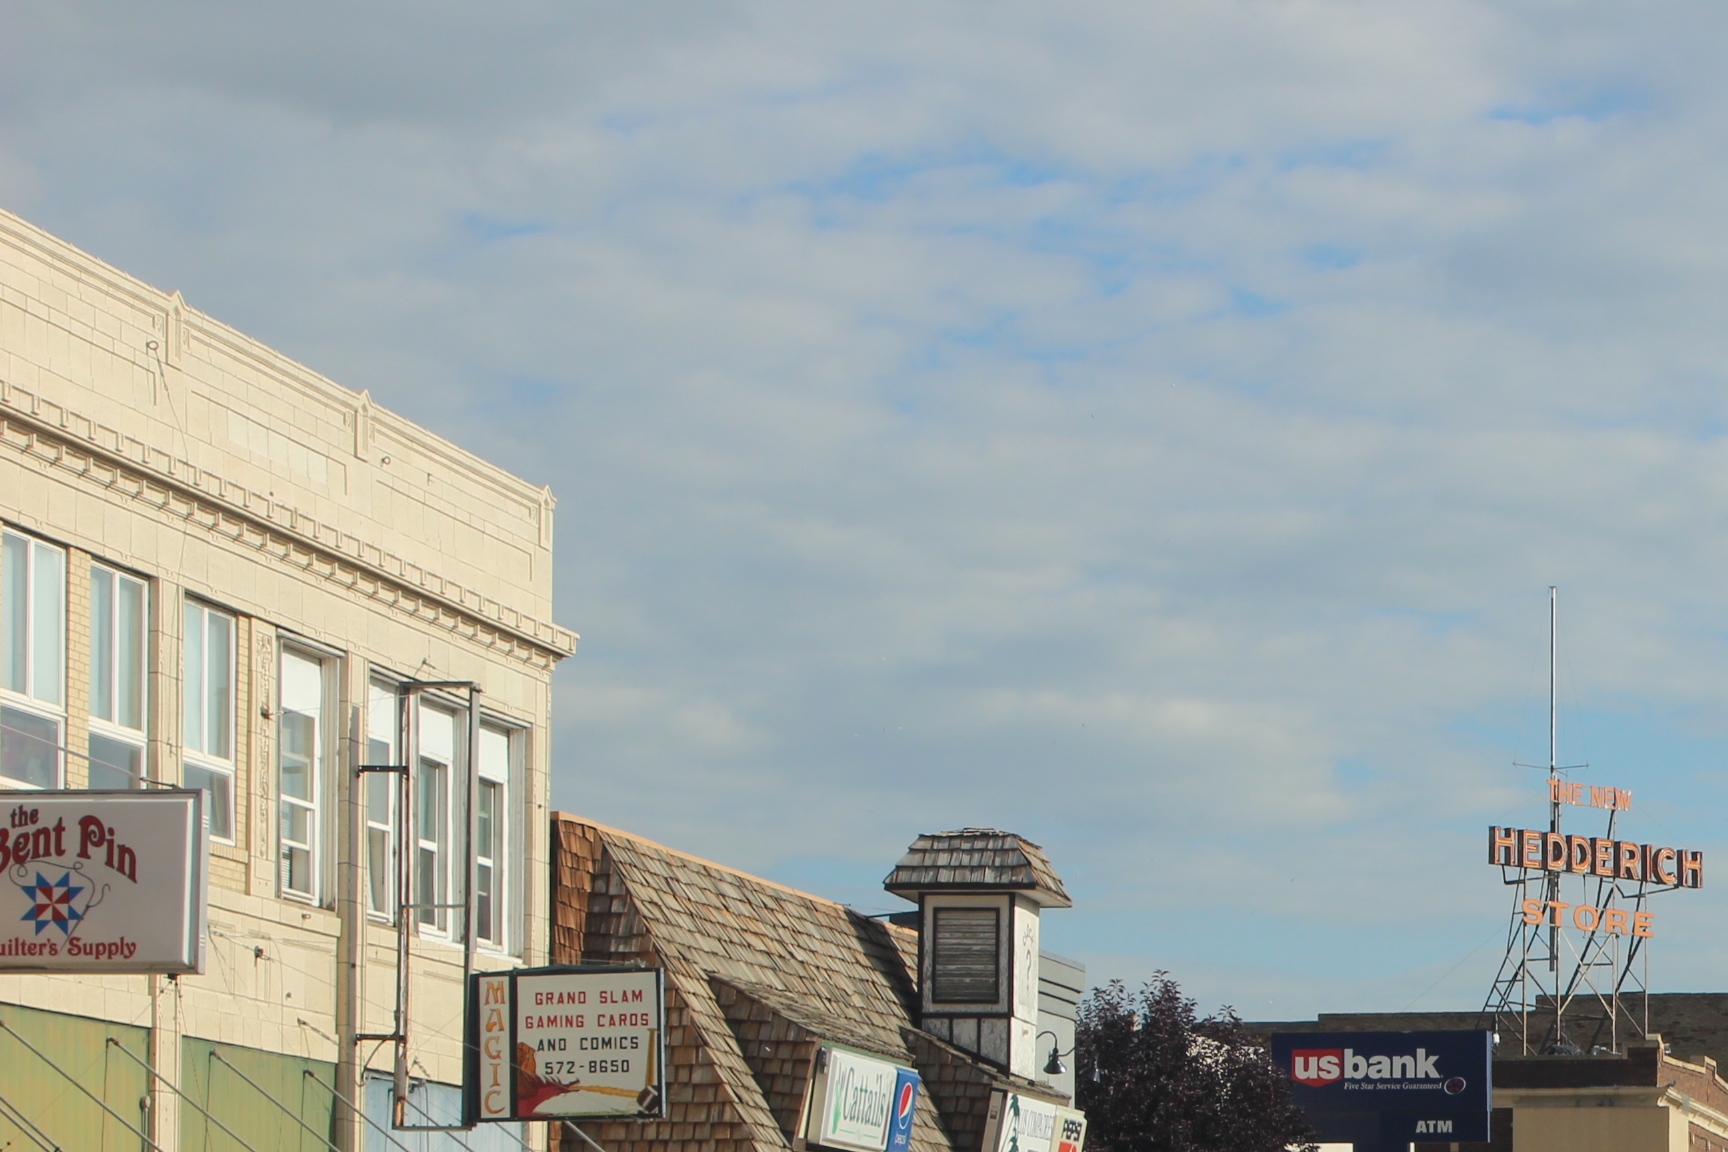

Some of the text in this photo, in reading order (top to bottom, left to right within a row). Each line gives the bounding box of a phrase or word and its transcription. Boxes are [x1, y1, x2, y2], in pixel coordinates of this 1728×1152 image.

[1547, 779, 1632, 811] THE NEW
[10, 804, 39, 829] the
[76, 815, 137, 884] Pin
[1488, 825, 1703, 889] HEDDERICH
[1522, 898, 1655, 938] STORE
[67, 936, 137, 960] Supply
[535, 990, 643, 1006] GRAND SLAM
[525, 1012, 650, 1030] GAMING CARDS
[483, 981, 507, 1115] MAGIC
[537, 1036, 639, 1052] AND COMICS
[545, 1059, 630, 1075] 572-8650
[842, 1065, 884, 1130] Cattails
[1344, 1082, 1442, 1090] Five Star Service Guaranteed
[1061, 1117, 1083, 1142] PEPSI
[1416, 1120, 1453, 1133] ATM
